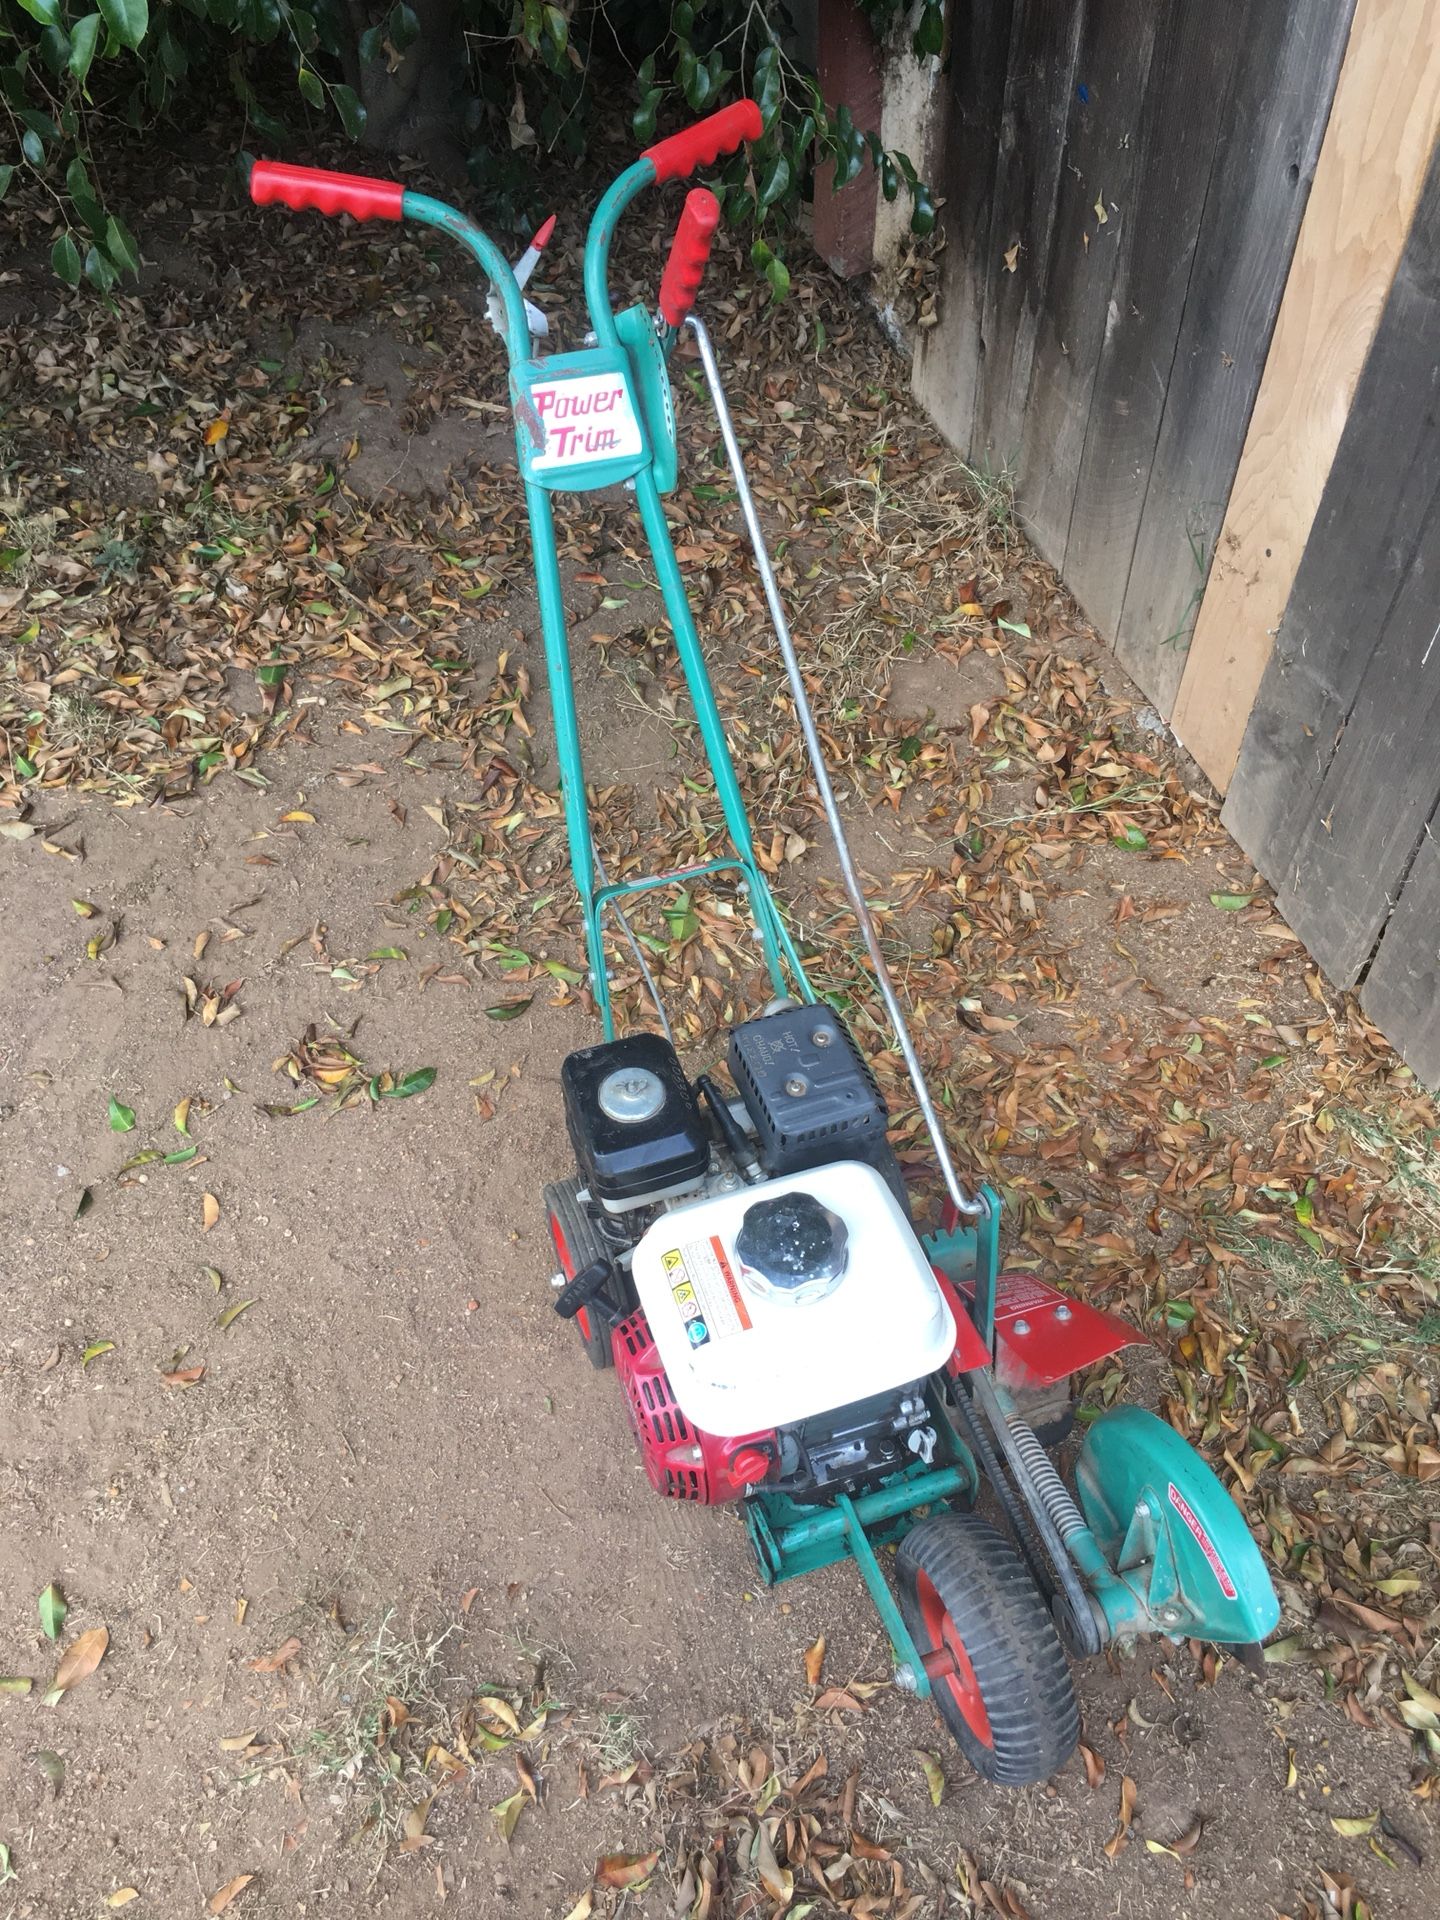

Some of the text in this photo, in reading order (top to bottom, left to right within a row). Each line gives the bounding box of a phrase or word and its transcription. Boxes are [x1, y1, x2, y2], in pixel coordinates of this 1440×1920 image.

[532, 389, 624, 419] Power
[549, 425, 622, 458] Trim
[782, 1031, 801, 1052] HOT!
[724, 1270, 741, 1304] WARNING
[1169, 1488, 1206, 1537] DANGER
